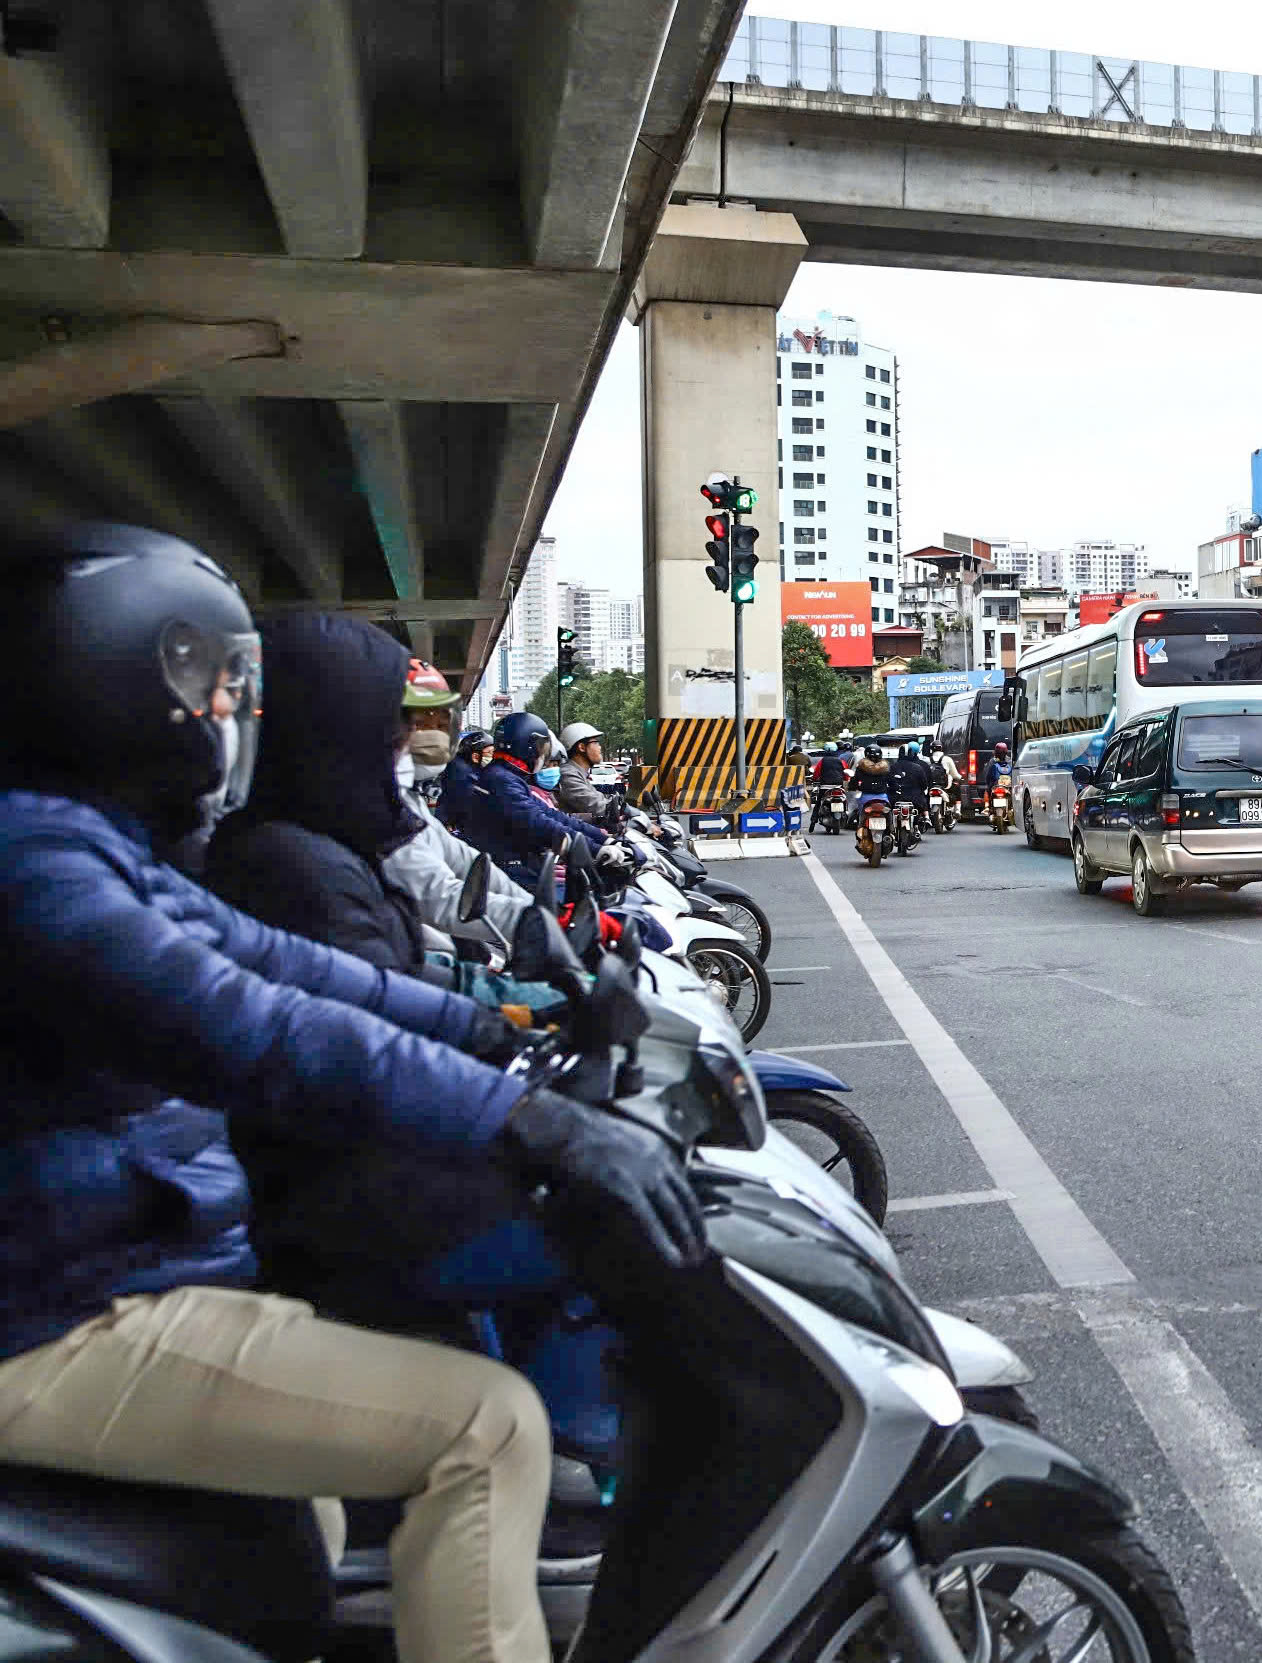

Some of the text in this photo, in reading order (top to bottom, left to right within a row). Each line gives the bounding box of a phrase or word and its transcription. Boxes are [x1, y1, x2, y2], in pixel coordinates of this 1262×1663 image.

[830, 623, 846, 637] 20
[850, 623, 866, 637] 99
[919, 675, 968, 684] SUNSHINE
[914, 684, 973, 693] BOULEVARD
